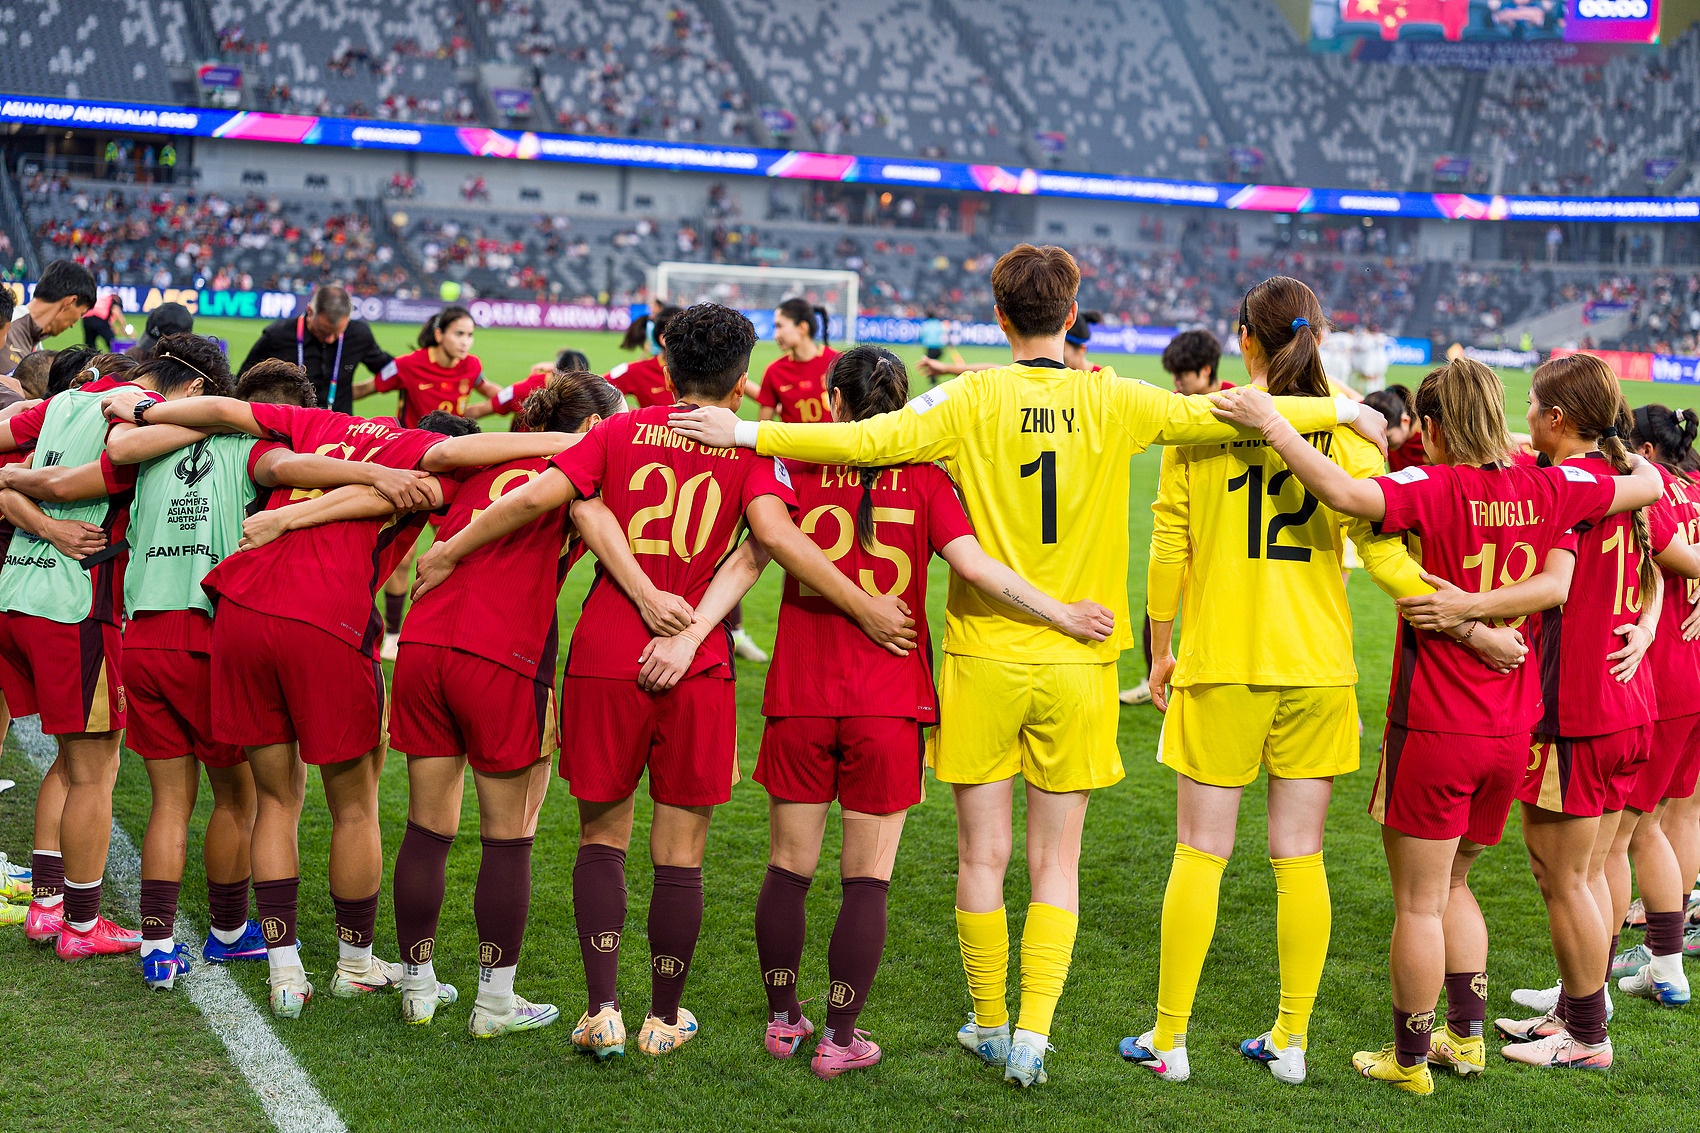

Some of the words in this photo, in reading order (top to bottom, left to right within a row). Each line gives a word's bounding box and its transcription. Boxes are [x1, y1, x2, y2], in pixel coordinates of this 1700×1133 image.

[1, 101, 44, 118] ASIAN
[44, 103, 74, 120] CUP
[73, 105, 158, 127] AUSTRALIA
[200, 290, 257, 317] LIVE
[260, 292, 297, 318] APP
[470, 301, 542, 328] QATAR
[544, 305, 632, 331] AIRWAYS
[794, 397, 823, 423] 10
[1020, 407, 1055, 433] ZHU
[1061, 407, 1080, 433] Y.
[632, 422, 695, 453] ZHANG
[167, 507, 194, 516] ASIAN
[627, 462, 722, 564] 20
[1020, 451, 1057, 544] 1
[1228, 465, 1319, 563] 12
[799, 504, 916, 598] 25
[1462, 541, 1538, 630] 18
[1601, 525, 1645, 615] 13
